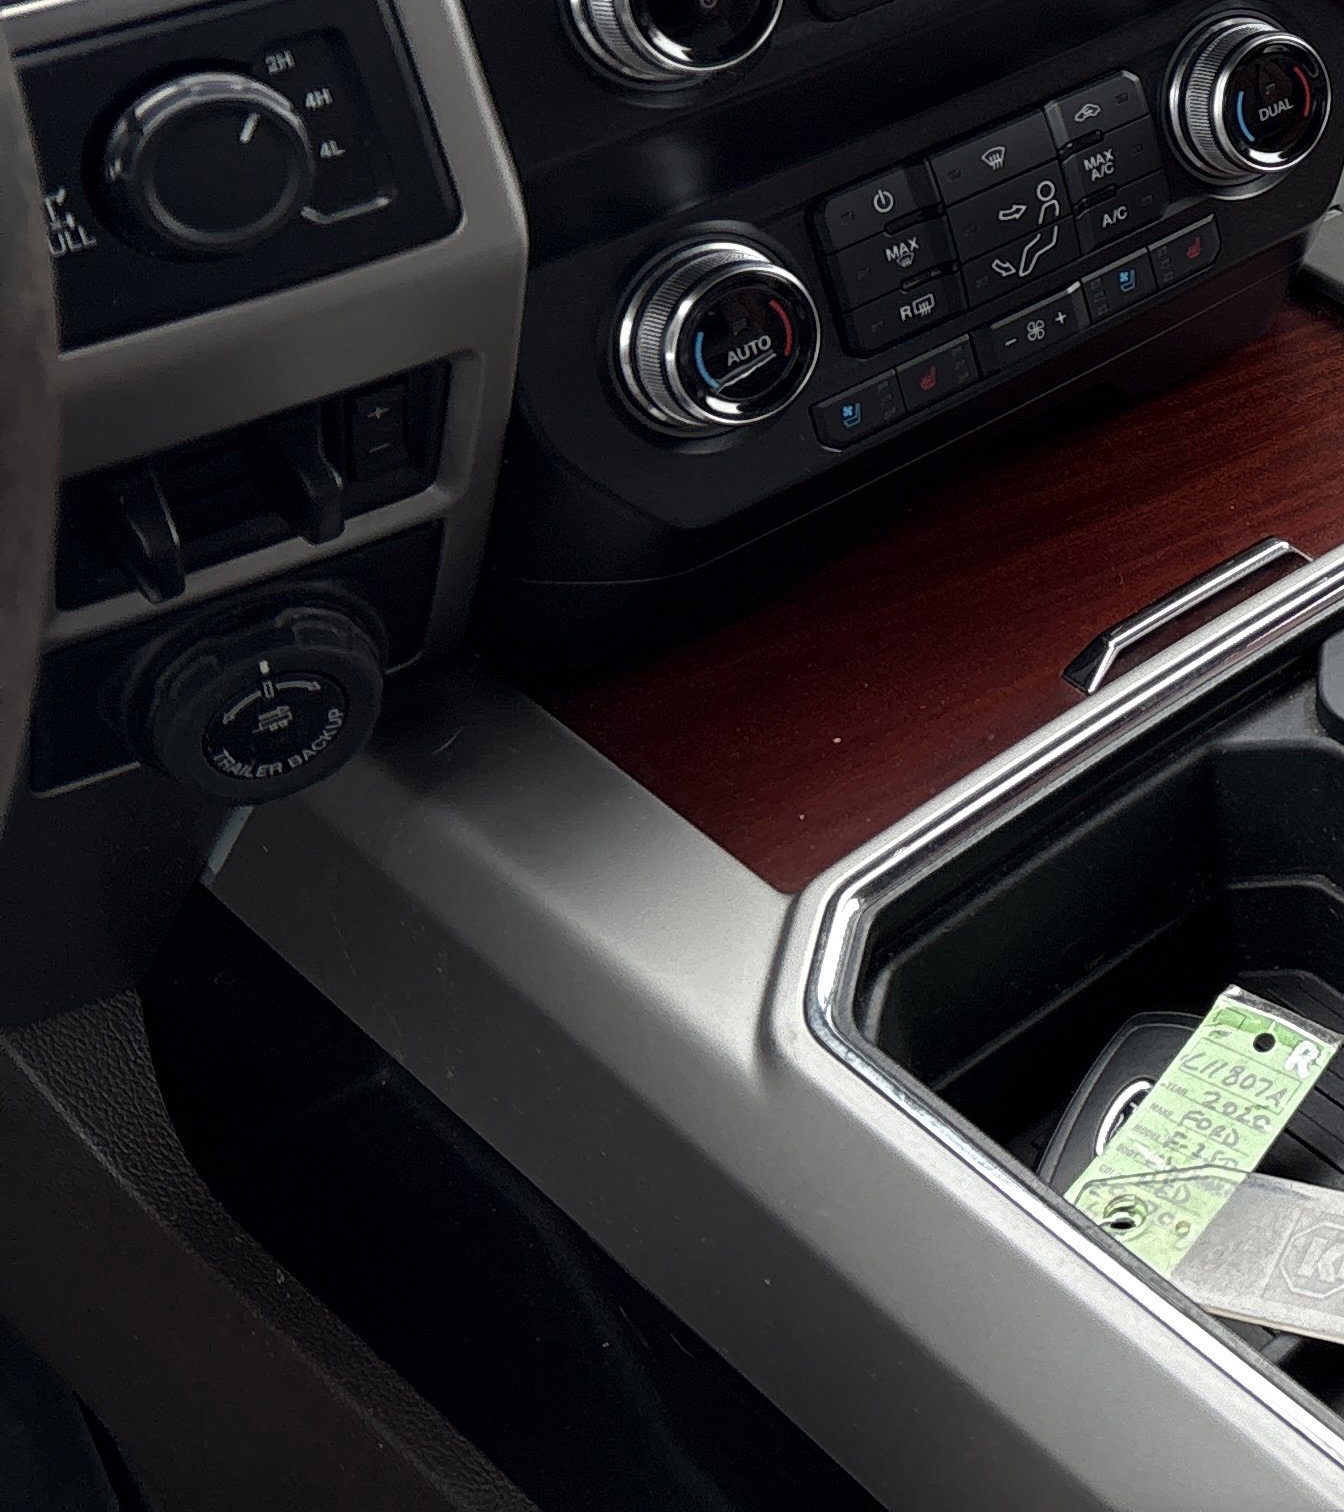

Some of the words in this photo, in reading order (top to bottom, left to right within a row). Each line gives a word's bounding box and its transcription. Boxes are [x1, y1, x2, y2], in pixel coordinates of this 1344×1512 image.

[265, 50, 295, 75] 2H
[305, 88, 333, 111] 4H
[1258, 98, 1294, 122] DUAL
[320, 140, 346, 159] 4L
[1083, 149, 1115, 172] MAX
[1090, 161, 1116, 182] A/C
[1101, 206, 1128, 228] A/C
[885, 237, 919, 263] MAX
[900, 305, 913, 322] R
[727, 335, 772, 367] AUTO
[212, 748, 283, 778] TRAILER
[286, 708, 344, 769] BACKUP
[1283, 1040, 1322, 1080] R
